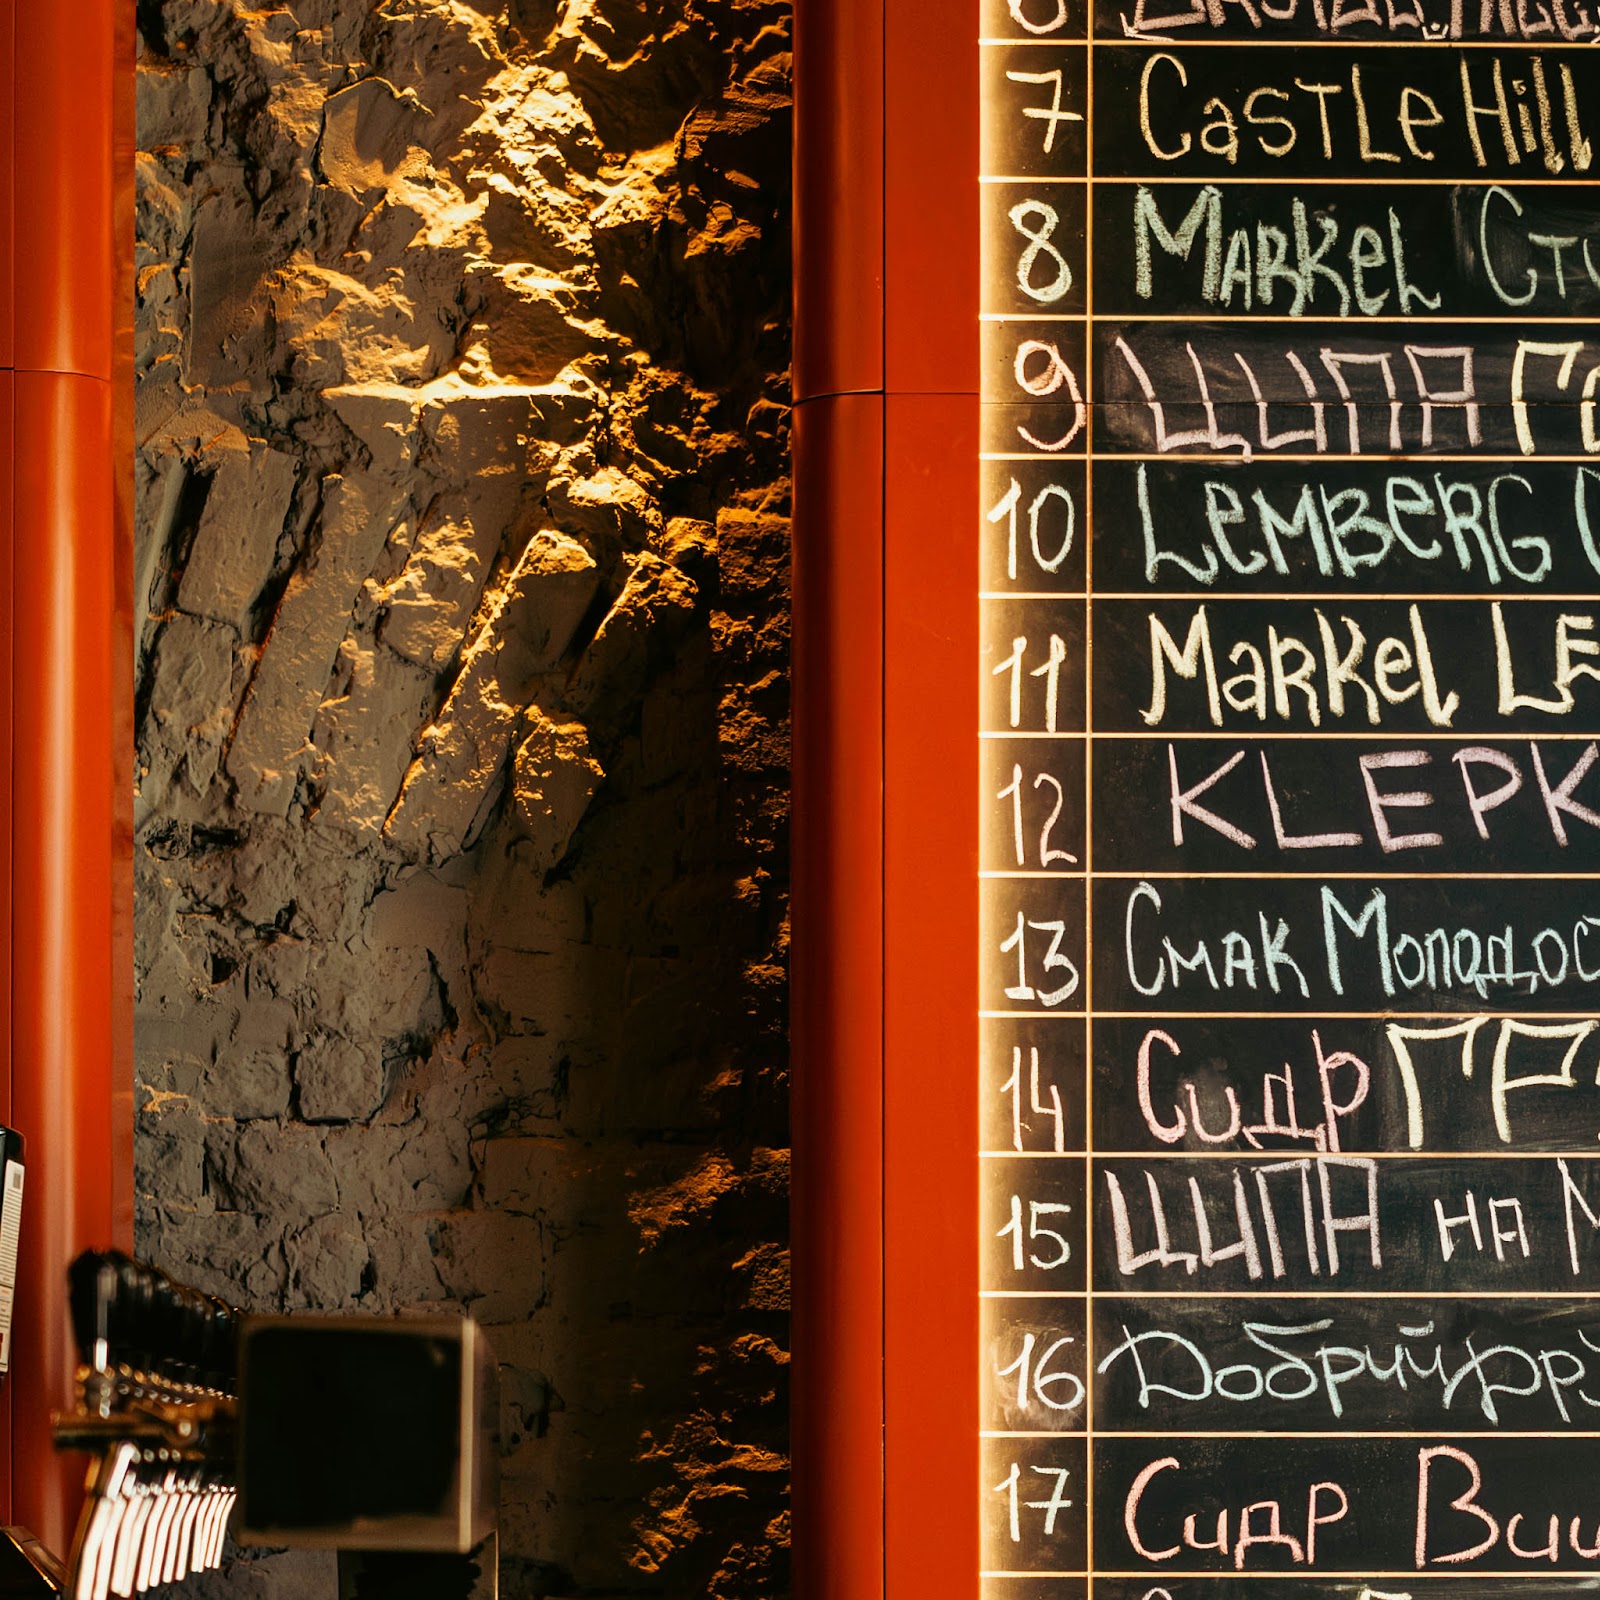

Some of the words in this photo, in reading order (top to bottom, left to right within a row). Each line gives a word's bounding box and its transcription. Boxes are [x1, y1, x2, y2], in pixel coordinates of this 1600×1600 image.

[1005, 69, 1083, 153] 7
[1007, 199, 1072, 303] 8
[1014, 339, 1088, 452] 9
[987, 475, 1075, 580] 10
[992, 636, 1066, 732] 11
[996, 763, 1077, 867] 12
[1000, 909, 1083, 1006] 13
[1000, 1046, 1063, 1152] 14
[996, 1200, 1071, 1270] 15
[996, 1333, 1087, 1412] 16
[1000, 1465, 1072, 1542] 17
